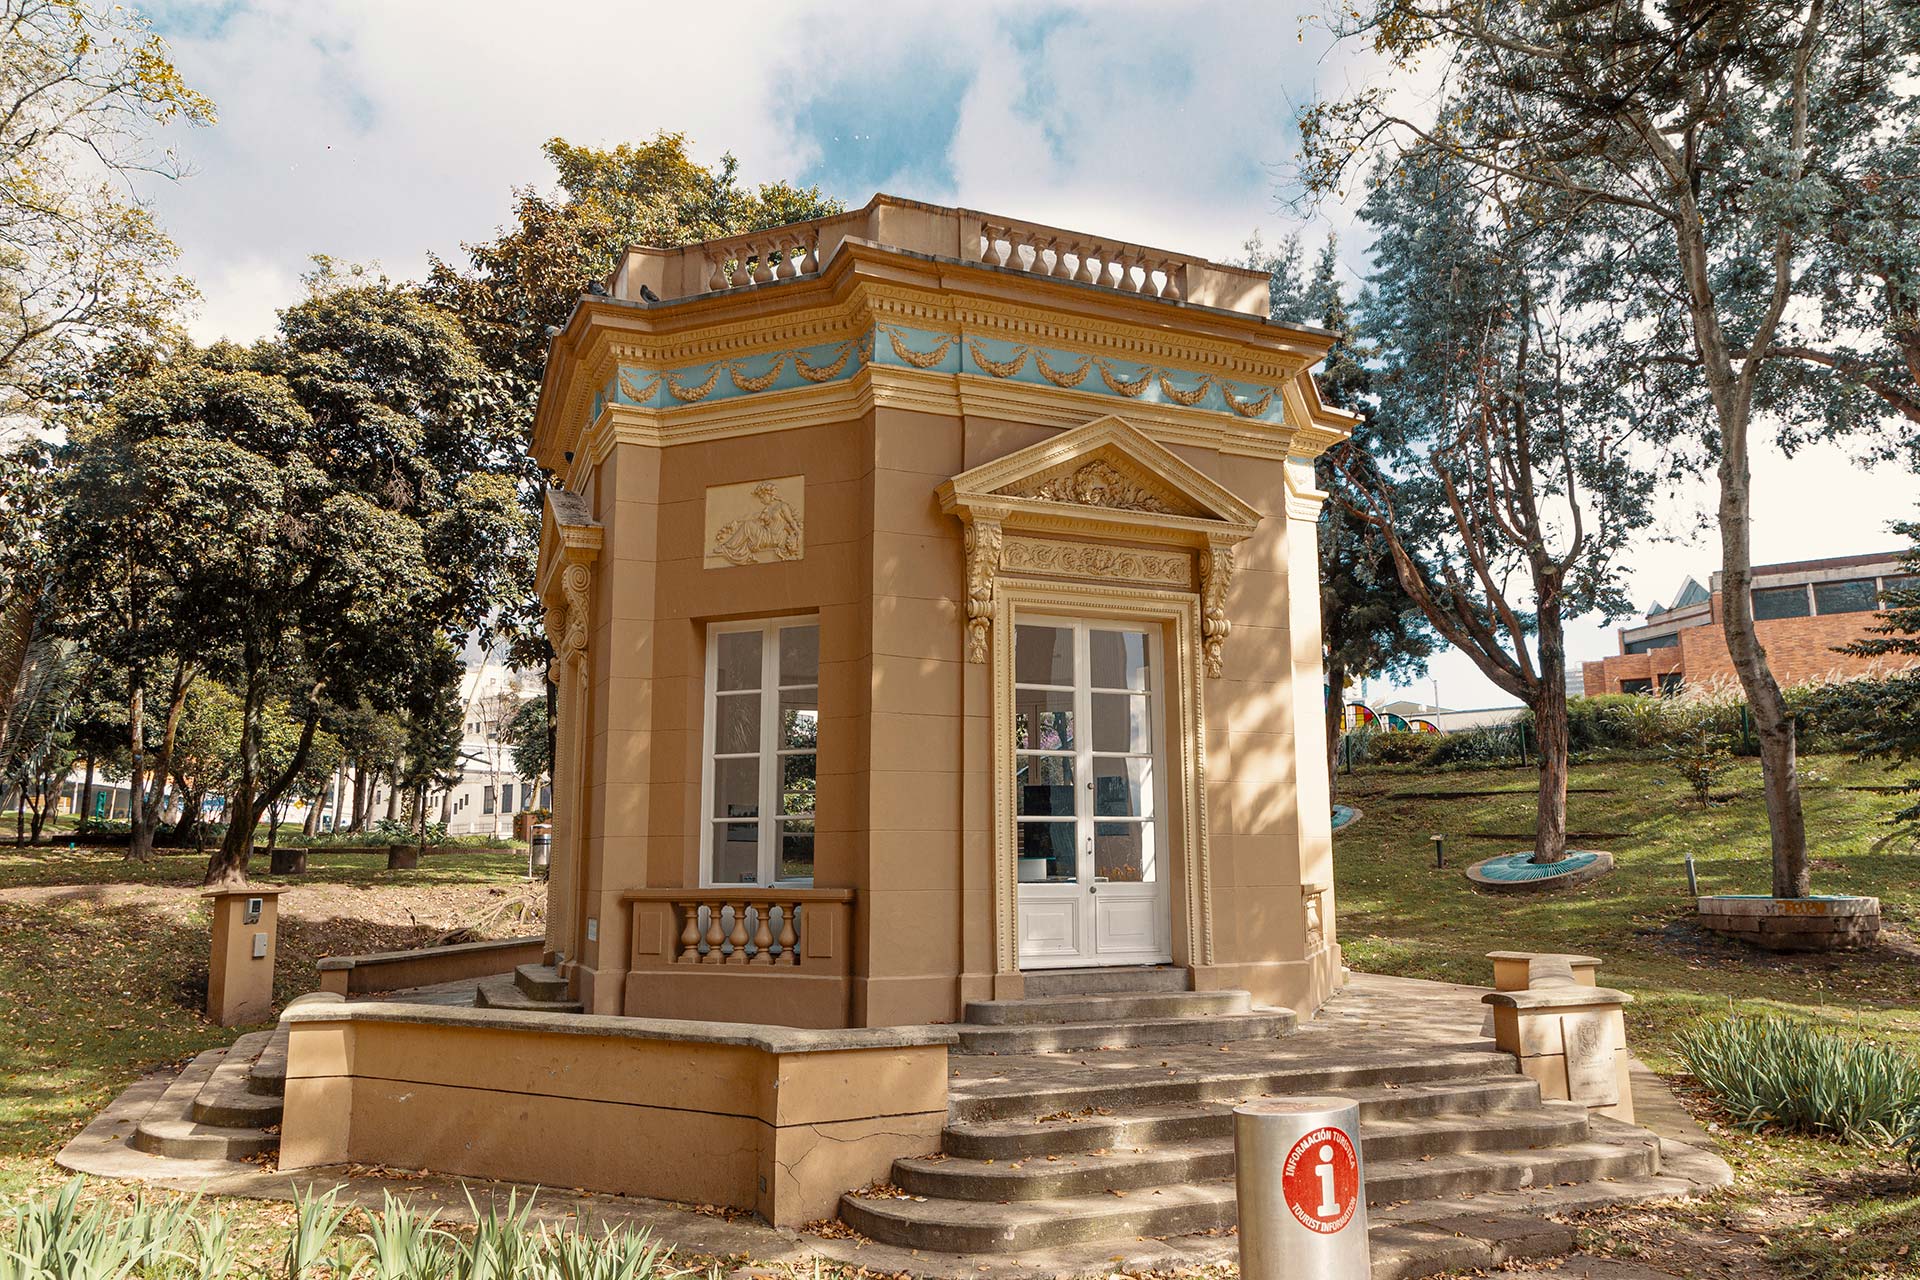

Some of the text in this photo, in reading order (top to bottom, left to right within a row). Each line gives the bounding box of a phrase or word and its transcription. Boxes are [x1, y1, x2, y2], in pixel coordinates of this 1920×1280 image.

[1285, 1128, 1332, 1177] INFORMACIÓN
[1291, 1195, 1356, 1232] TOURIST INFORMATION
